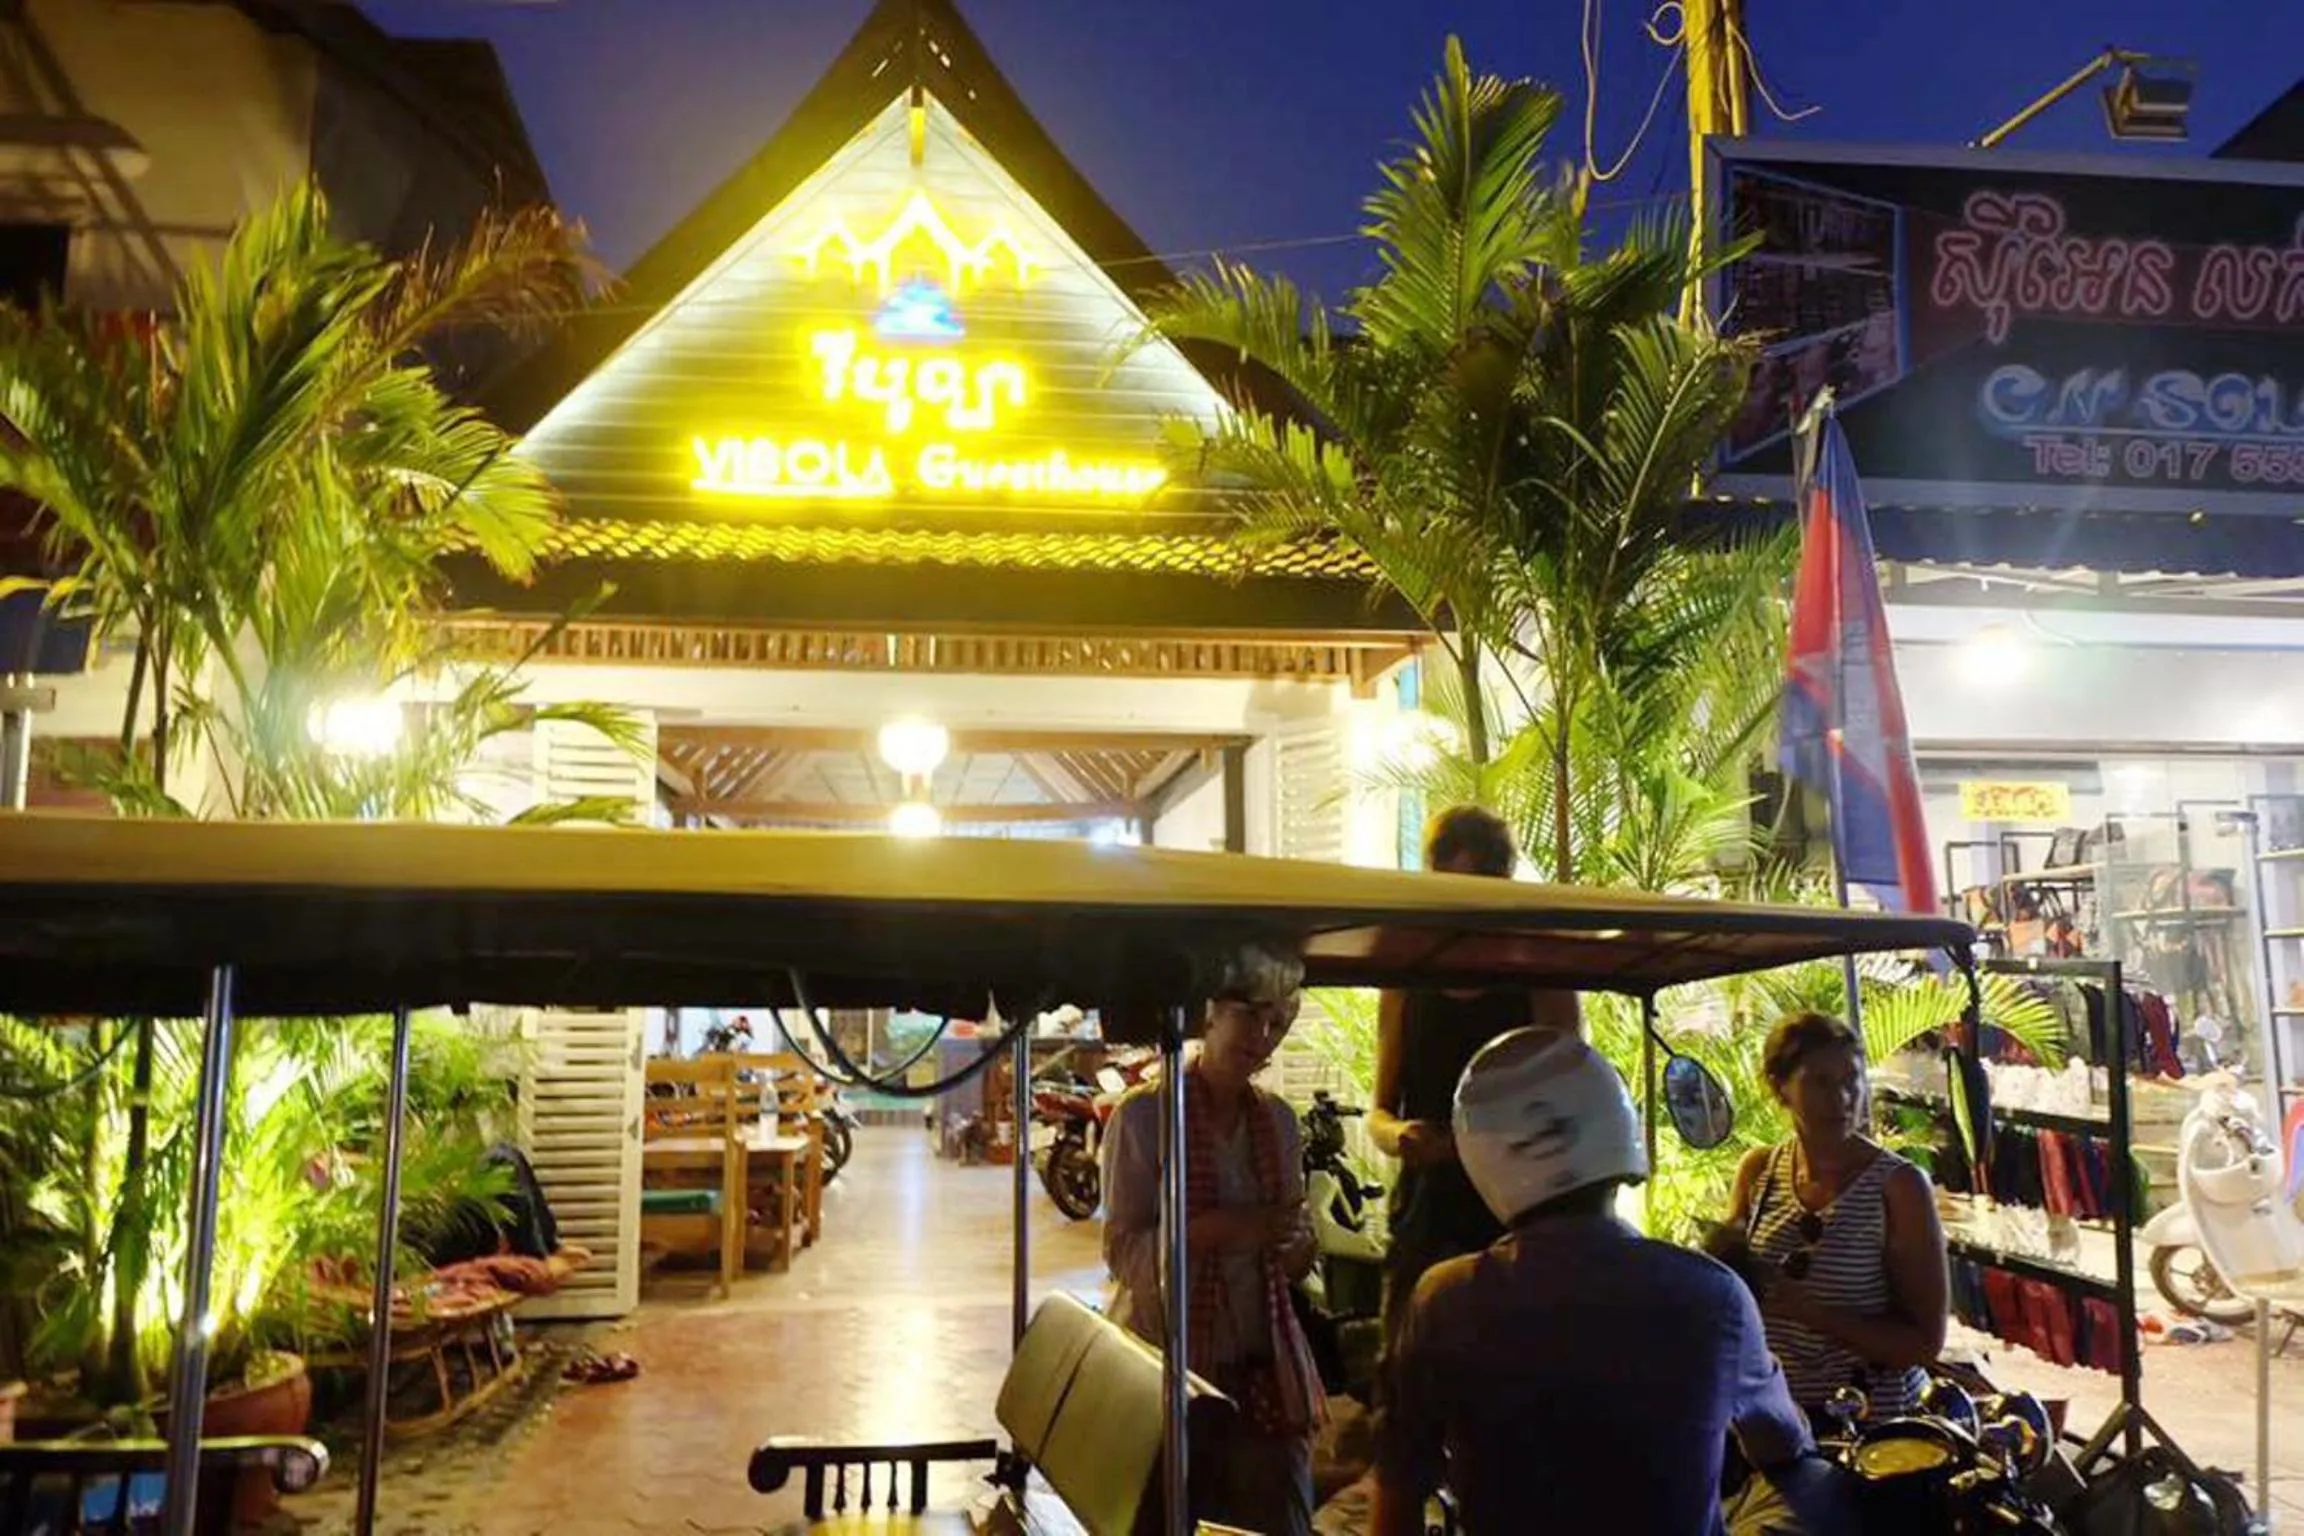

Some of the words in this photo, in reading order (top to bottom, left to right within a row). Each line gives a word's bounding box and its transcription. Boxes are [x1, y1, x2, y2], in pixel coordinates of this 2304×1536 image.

[690, 436, 893, 494] VIBOLA
[916, 442, 1168, 494] Guesthouse
[2023, 433, 2111, 478] Tel:
[2123, 437, 2220, 481] 017
